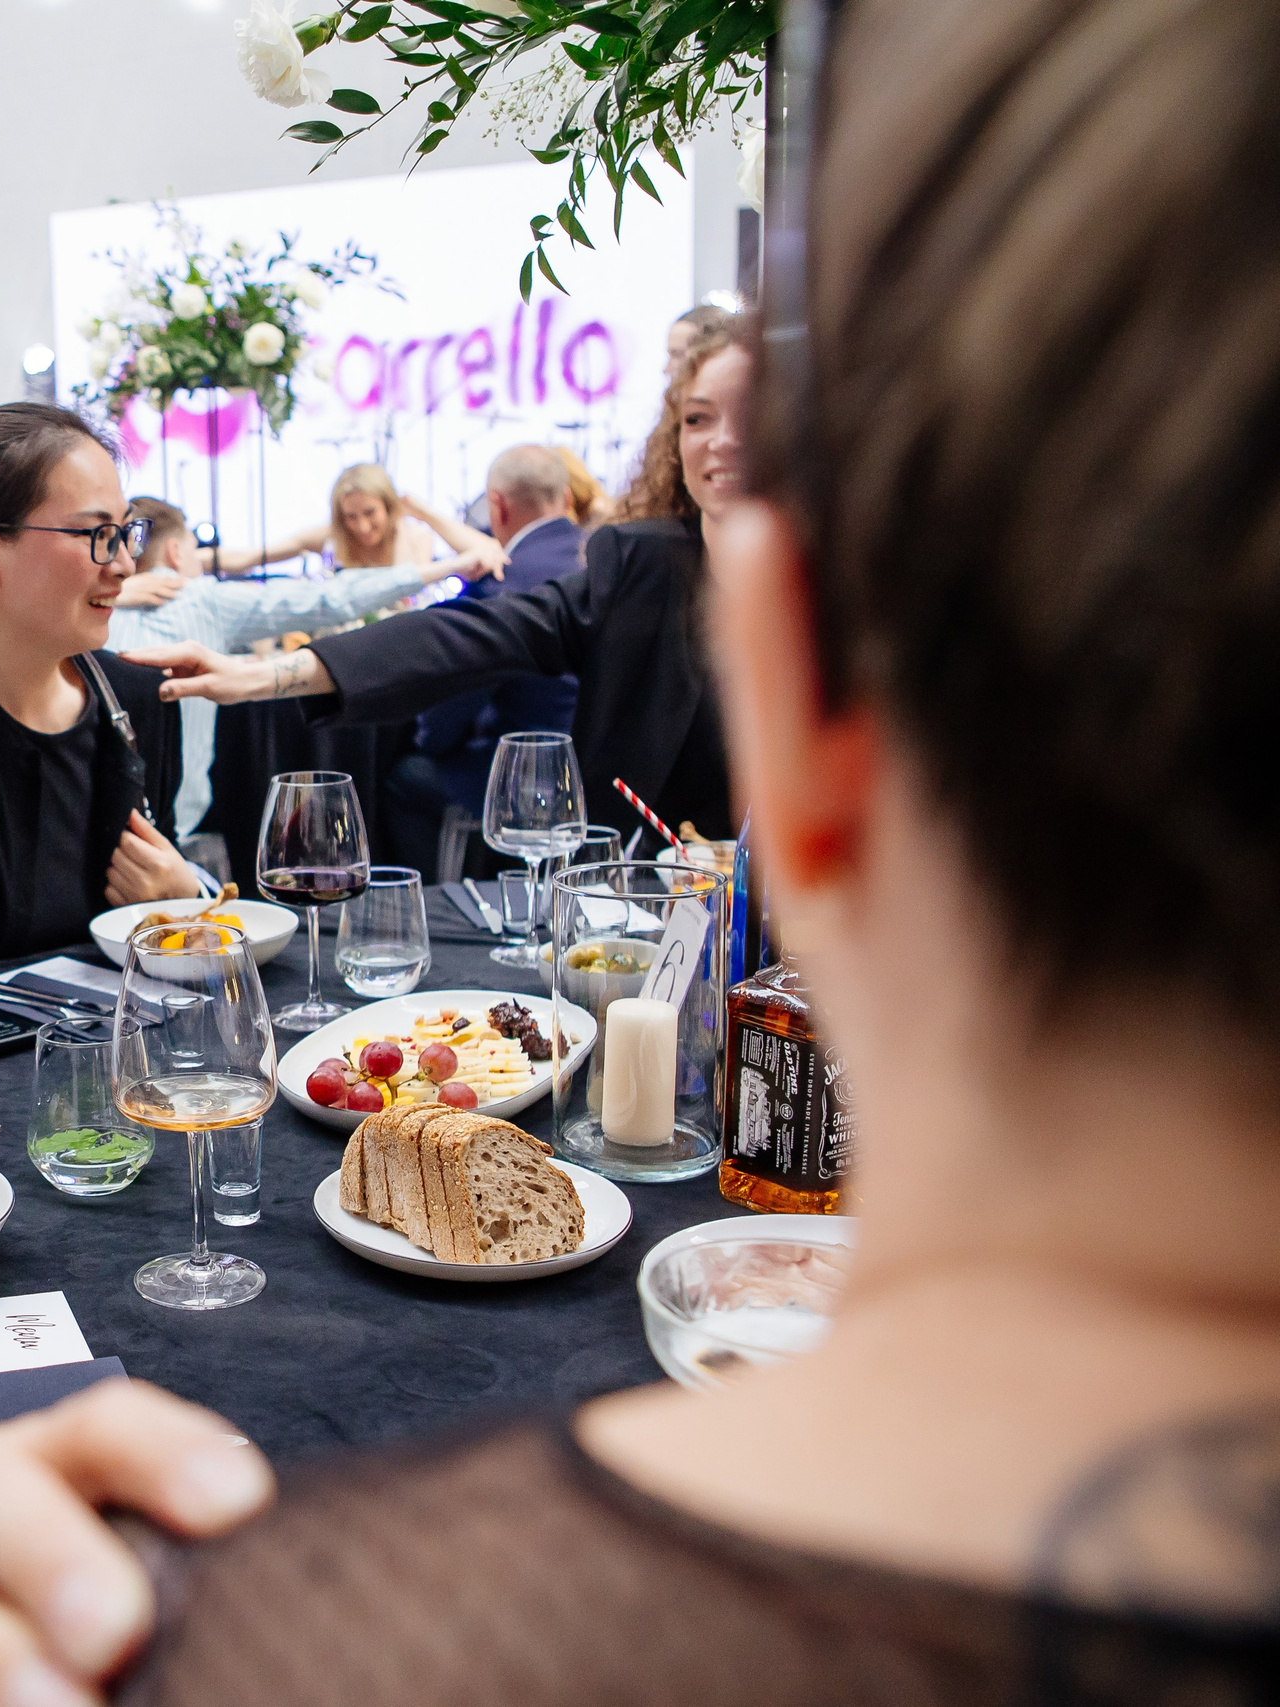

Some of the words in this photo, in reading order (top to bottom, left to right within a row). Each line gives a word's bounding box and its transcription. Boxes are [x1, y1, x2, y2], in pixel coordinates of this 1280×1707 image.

[334, 298, 619, 416] arrello
[783, 1041, 794, 1065] OLD
[788, 1065, 798, 1095] TIME
[806, 1079, 814, 1098] DROP
[804, 1123, 811, 1132] IN
[832, 1111, 856, 1127] Tenne
[828, 1130, 857, 1145] WHIS
[801, 1135, 810, 1175] TENNESSEE
[4, 1314, 57, 1351] Menu
